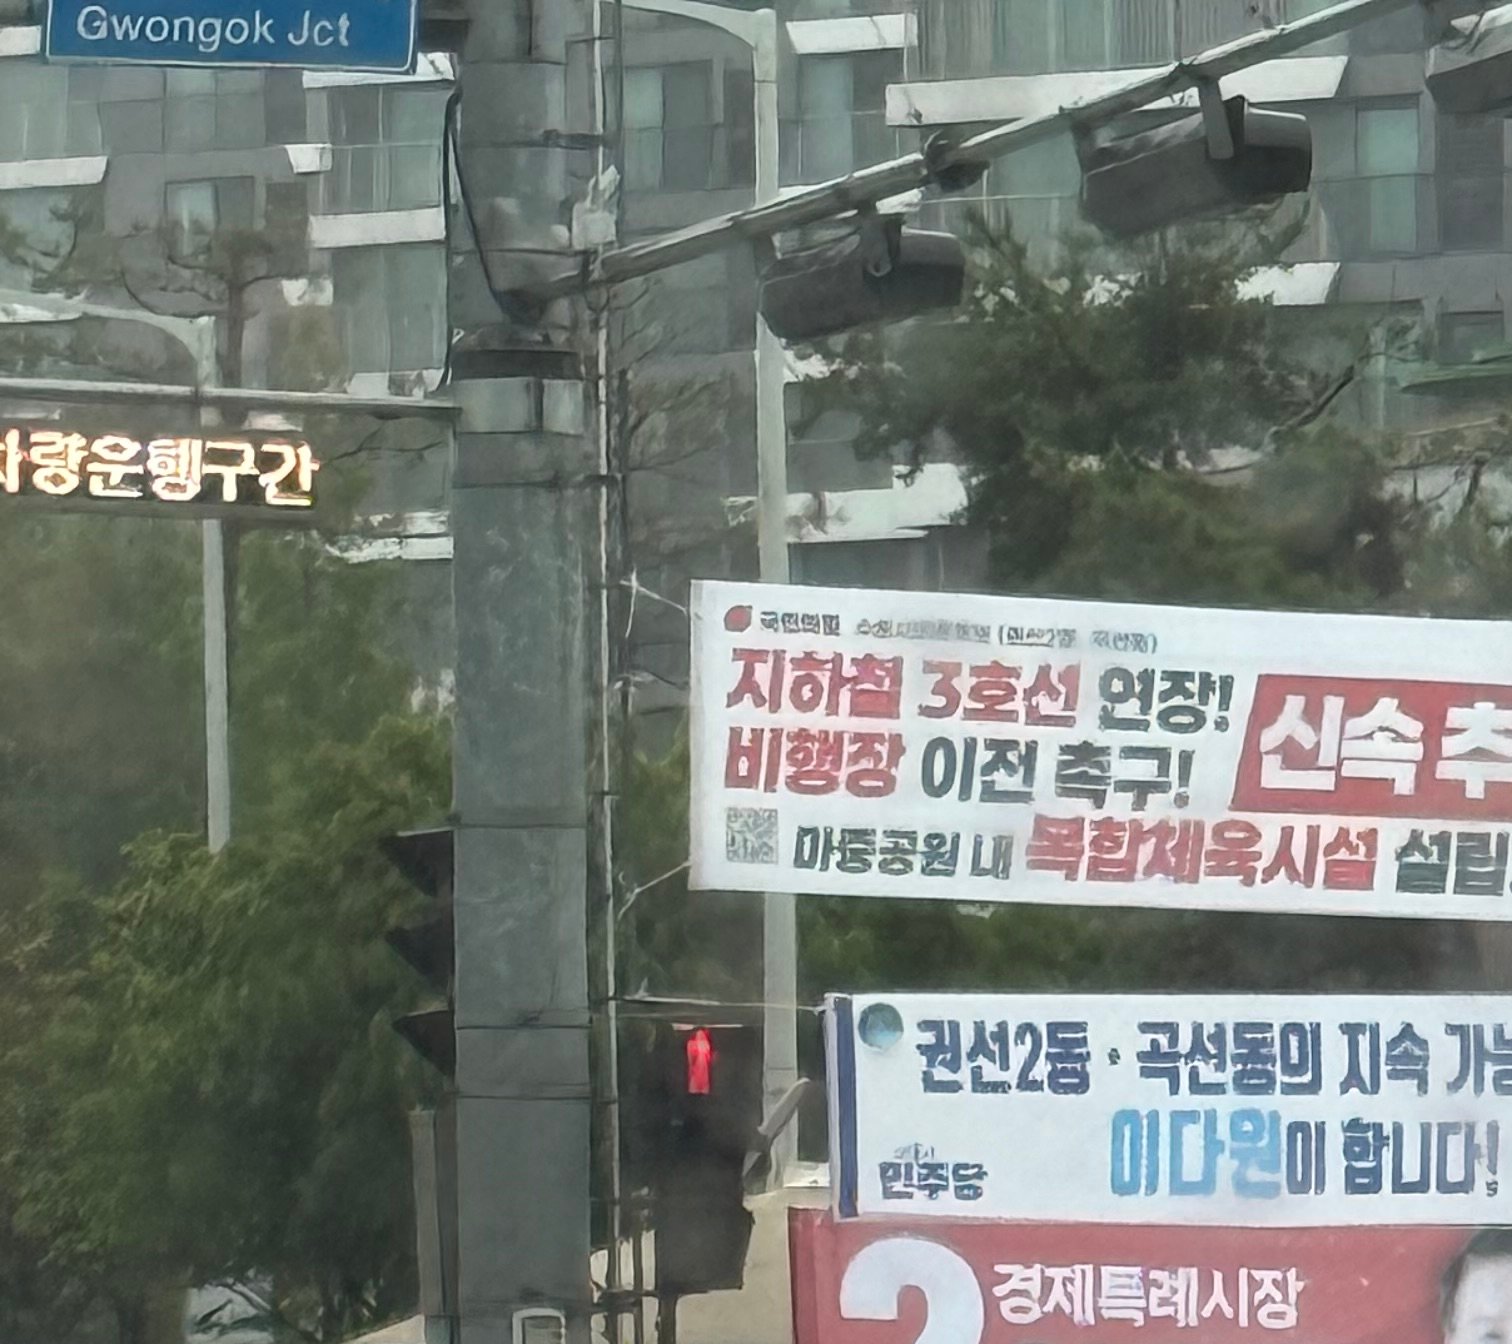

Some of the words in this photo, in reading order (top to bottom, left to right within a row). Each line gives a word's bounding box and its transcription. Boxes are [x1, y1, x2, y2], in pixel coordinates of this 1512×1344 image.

[77, 6, 275, 52] Gwongok
[288, 10, 350, 46] Jct
[726, 648, 903, 720] 지하철
[918, 659, 1080, 727] 3호선
[1099, 667, 1233, 734] 연장!
[724, 727, 906, 798] 비행장
[921, 736, 1039, 804] 이전
[1055, 739, 1195, 811] 촉구!
[1260, 695, 1424, 796] 신속
[969, 834, 1014, 880] 내
[1026, 814, 1377, 890] 복합체육시설
[1136, 1020, 1322, 1096] 곡선동의
[1339, 1020, 1430, 1096] 지속
[879, 1161, 988, 1200] 민주당
[1341, 1117, 1500, 1197] 합니다!
[992, 1263, 1305, 1329] 경제특례시장
